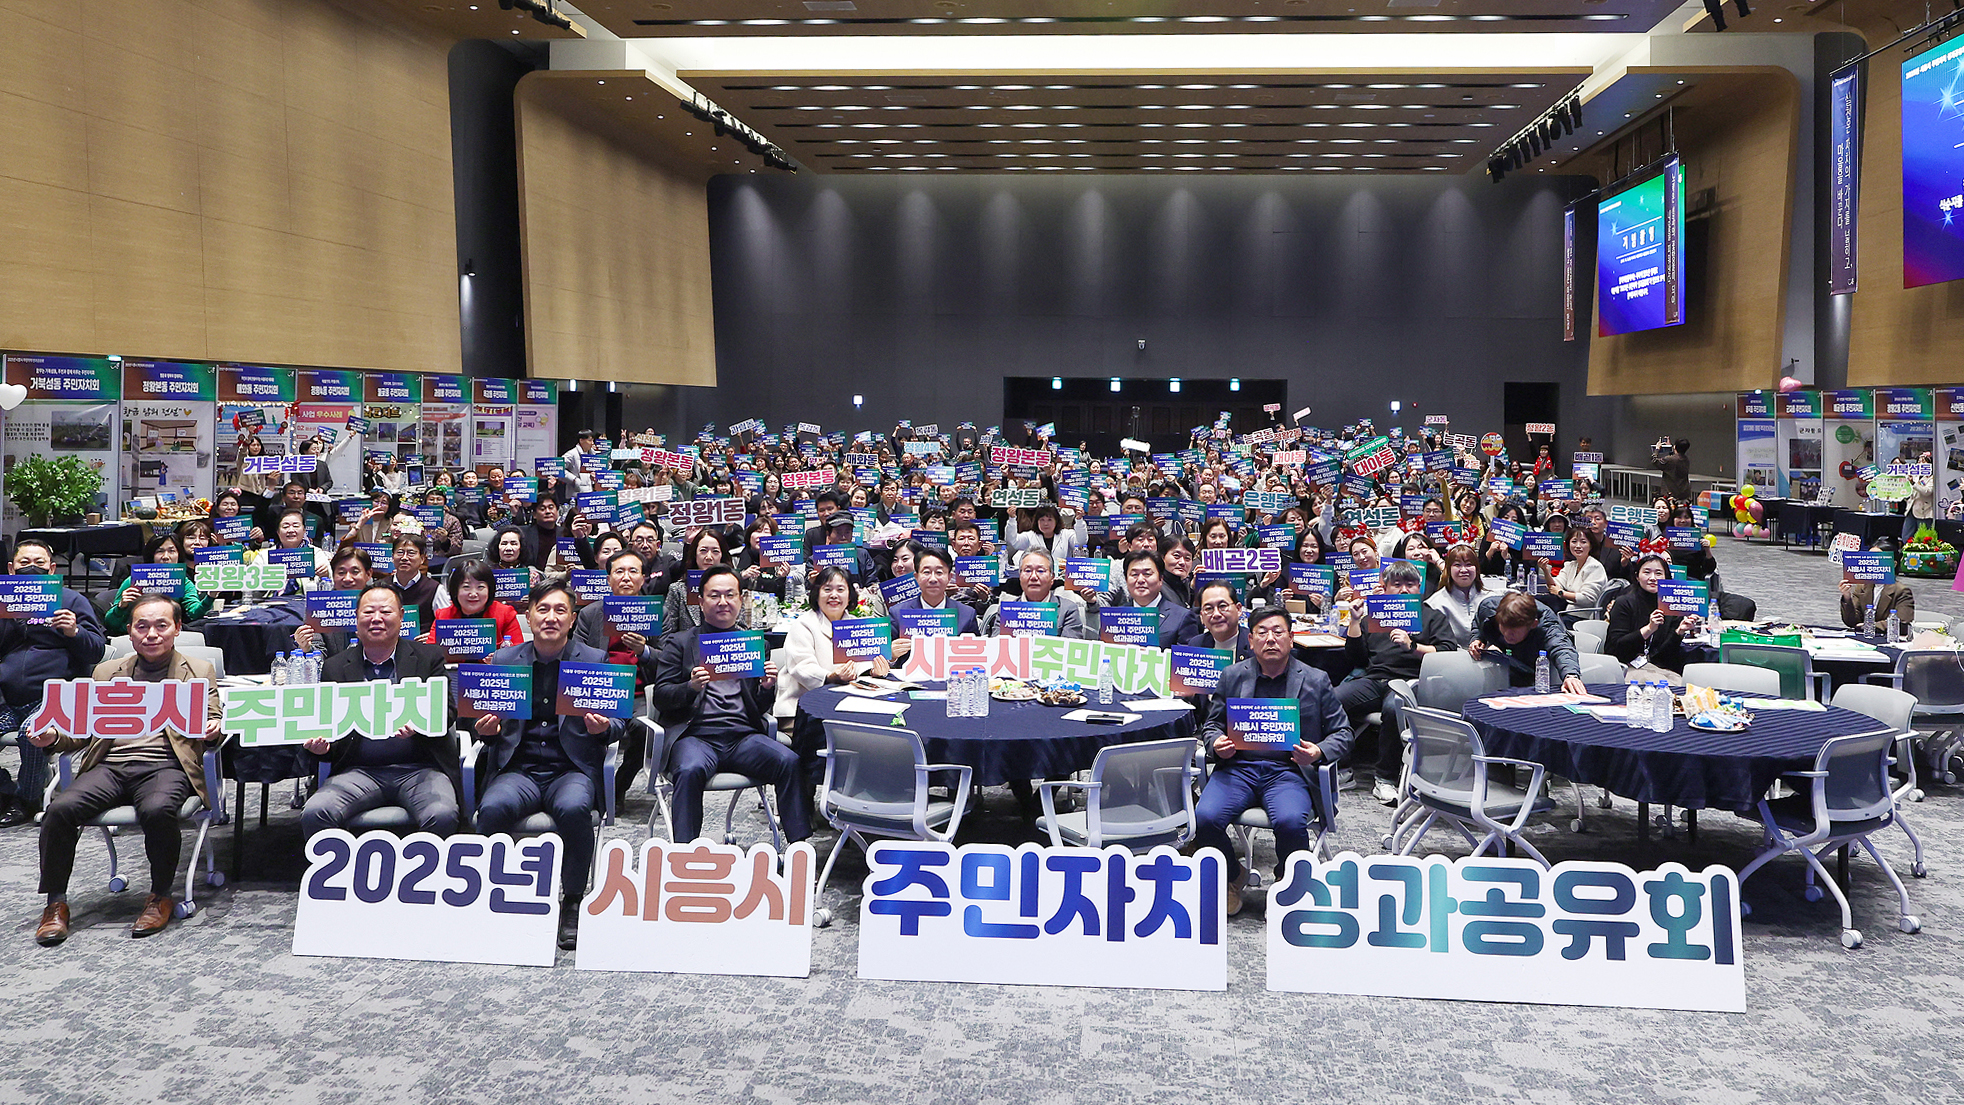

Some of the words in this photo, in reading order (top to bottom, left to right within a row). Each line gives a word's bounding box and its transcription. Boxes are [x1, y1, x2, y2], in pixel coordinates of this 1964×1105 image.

[30, 377, 62, 390] 거북섬동
[63, 378, 100, 391] 주민자치회
[143, 381, 168, 393] 정왕본동
[169, 382, 199, 394] 주민자치회
[1526, 424, 1555, 432] 정왕2동
[1244, 428, 1274, 444] 능곡동
[1444, 434, 1476, 448] 능곡동
[641, 448, 693, 469] 정왕본동
[846, 454, 878, 465] 매화동
[992, 447, 1050, 466] 정왕본동
[1273, 451, 1306, 464] 대야동
[1354, 448, 1395, 476] 대야동
[245, 456, 315, 472] 거북섬동
[1888, 464, 1932, 475] 거북섬동
[782, 470, 834, 487] 정왕본동
[618, 487, 672, 504] 정왕1동
[993, 489, 1039, 506] 연성동
[1244, 491, 1292, 508] 은행동
[670, 499, 744, 525] 정왕1동
[1612, 506, 1658, 524] 은행동
[1204, 550, 1280, 570] 배곧2동
[196, 566, 285, 589] 정왕3동
[6, 603, 47, 612] 성과공유회
[608, 614, 630, 622] 시흥시
[631, 614, 658, 622] 주민자치
[1026, 620, 1053, 629] 주민자치
[1105, 626, 1126, 634] 시흥시
[1127, 626, 1155, 634] 주민자치
[851, 629, 874, 637] 2025년
[904, 627, 924, 636] 시흥시
[926, 627, 953, 636] 주민자치
[837, 638, 859, 648] 시흥시
[860, 636, 887, 645] 주민자치
[1113, 634, 1146, 643] 성과공유회
[720, 643, 746, 652] 2025년
[846, 647, 880, 656] 성과공유회
[705, 654, 728, 663] 시흥시
[730, 652, 760, 661] 주민자치
[714, 663, 752, 673] 성과공유회
[906, 637, 1028, 679] 시흥시
[1032, 638, 1170, 696] 주민자치
[1189, 659, 1214, 668] 2025년
[1175, 667, 1196, 676] 시흥시
[480, 678, 510, 688] 2025년
[582, 676, 613, 687] 2025년
[463, 689, 488, 698] 시흥시
[491, 690, 526, 700] 주민자치
[564, 687, 590, 697] 시흥시
[593, 689, 629, 700] 주민자치
[473, 701, 516, 711] 성과공유회
[573, 699, 617, 710] 성과공유회
[34, 682, 206, 734] 시흥시
[224, 680, 444, 742] 주민자치
[1249, 711, 1278, 720] 2025년
[1233, 722, 1258, 731] 시흥시
[1260, 722, 1294, 732] 주민자치
[1243, 733, 1285, 742] 성과공유회
[307, 836, 550, 915] 2025년
[588, 846, 806, 926] 시흥시
[871, 849, 1220, 945] 주민자치
[1275, 858, 1734, 965] 성과공유회
